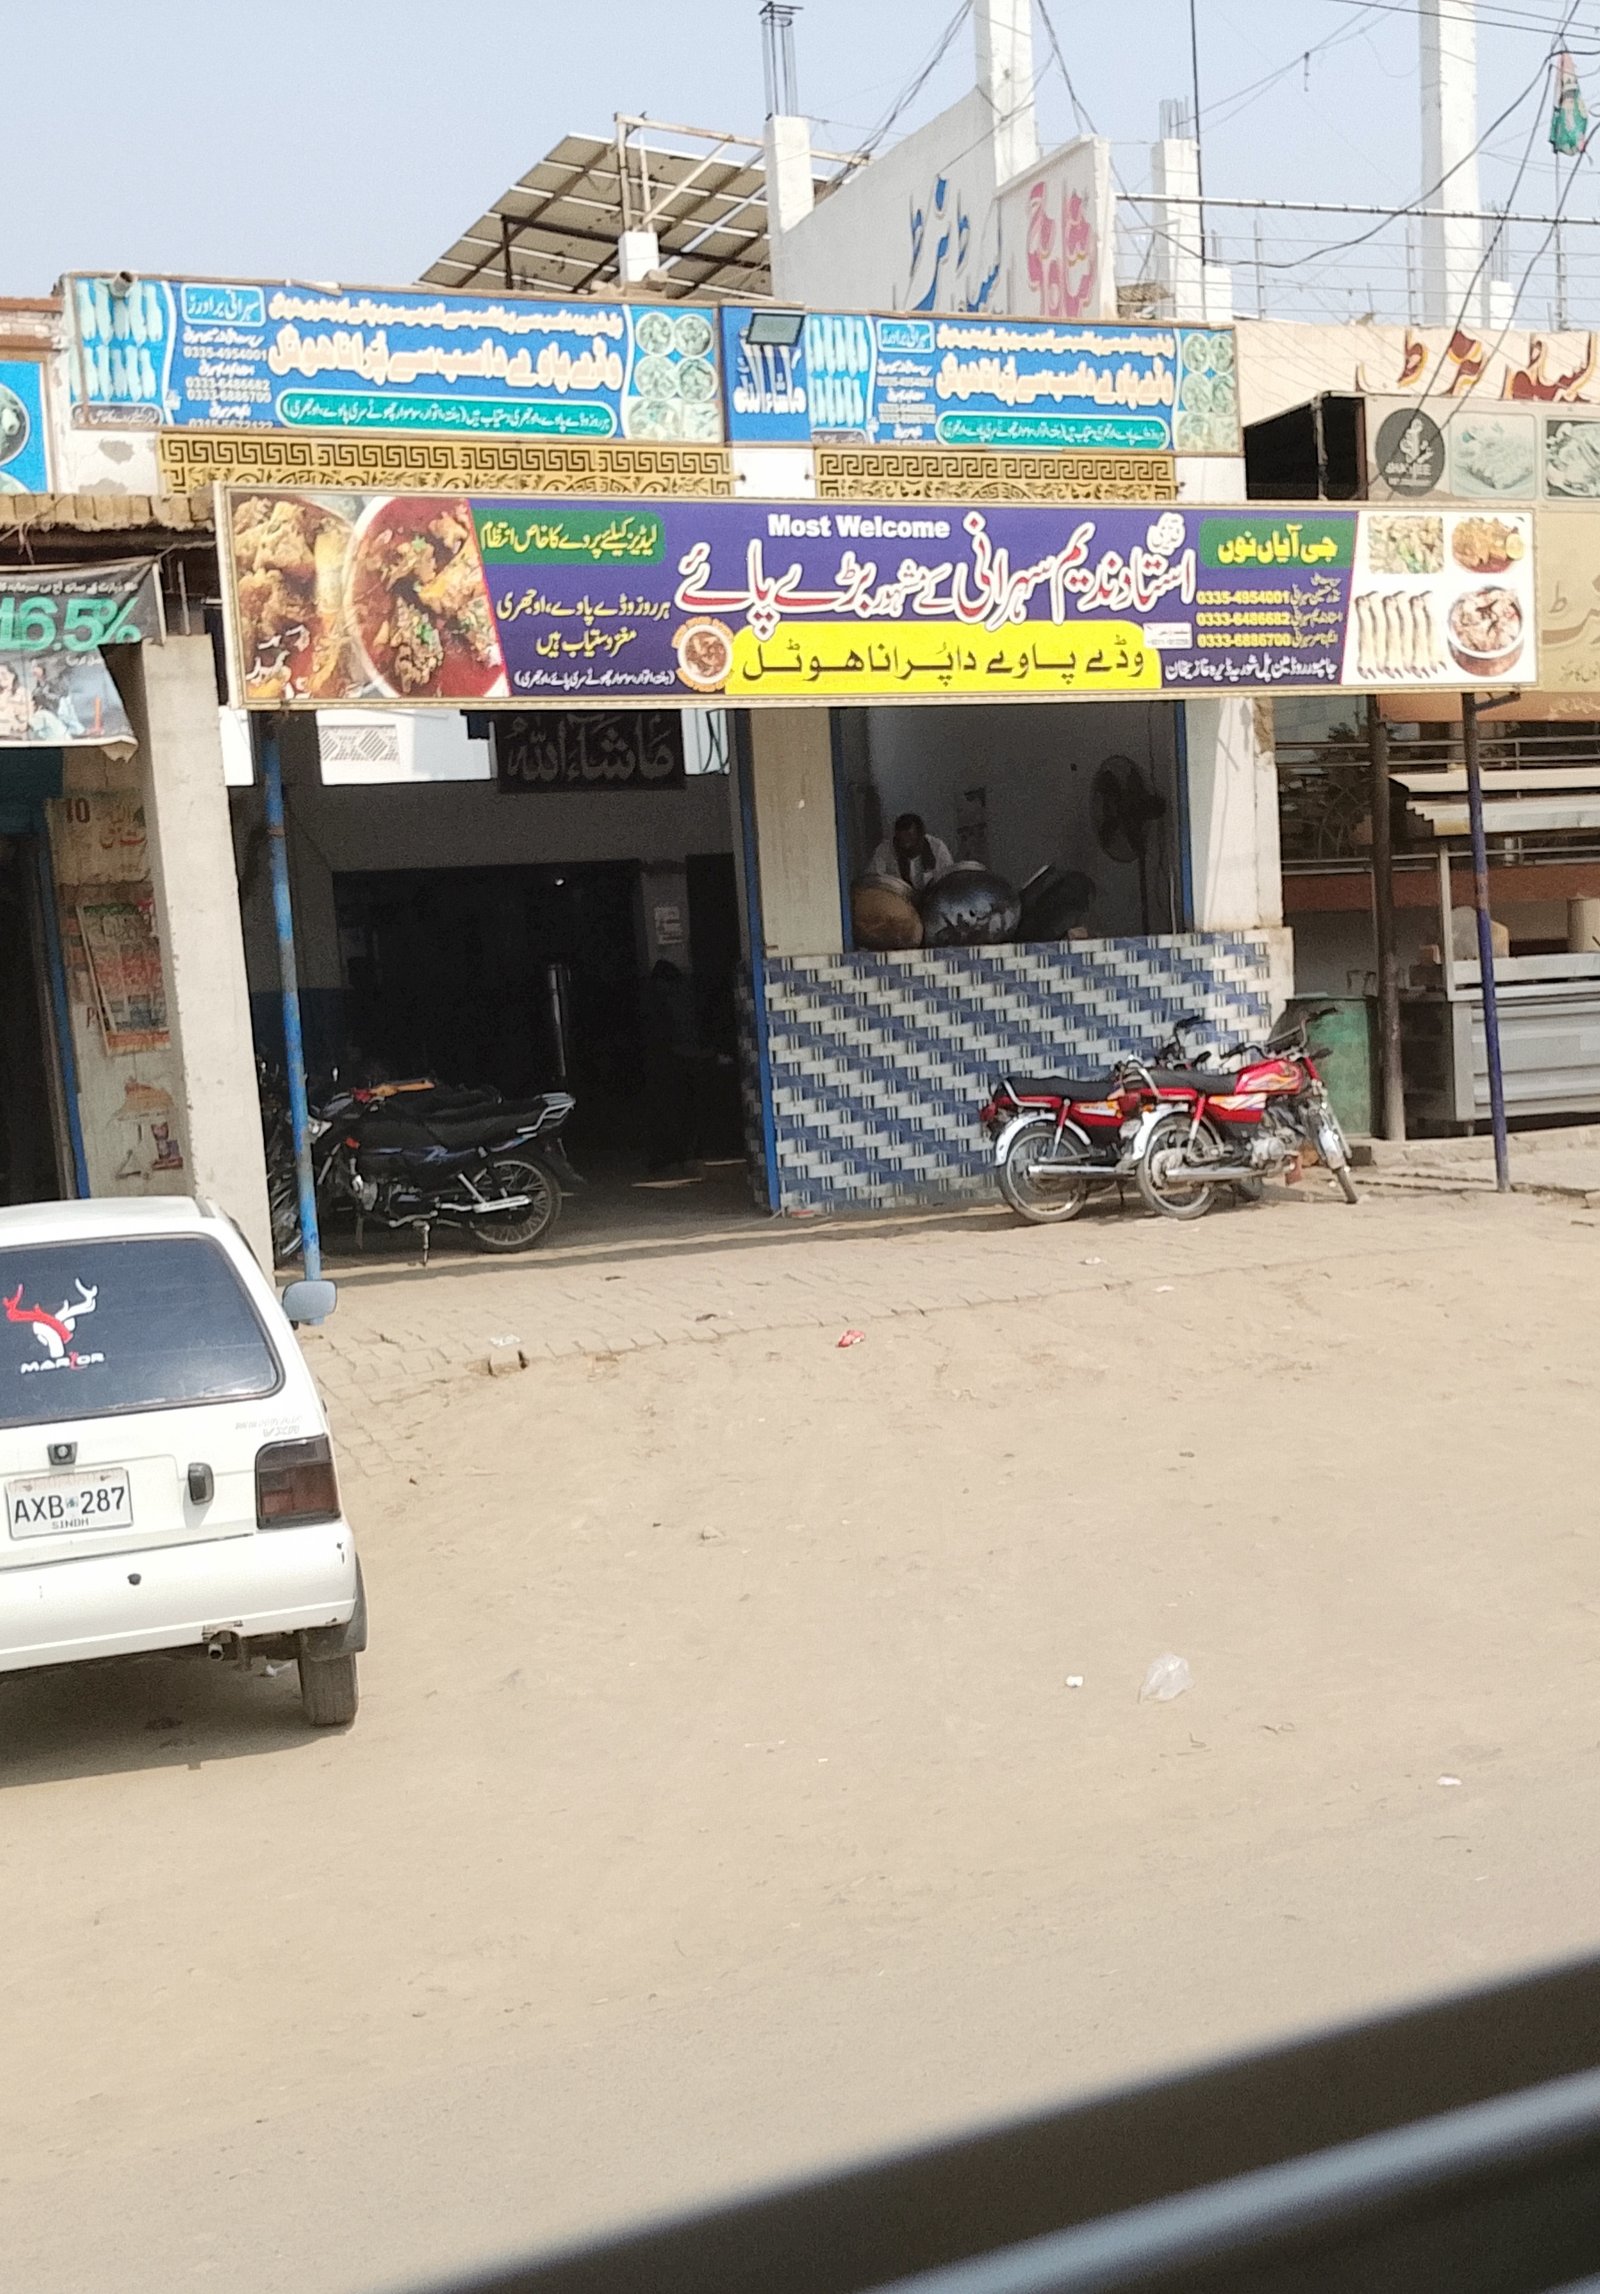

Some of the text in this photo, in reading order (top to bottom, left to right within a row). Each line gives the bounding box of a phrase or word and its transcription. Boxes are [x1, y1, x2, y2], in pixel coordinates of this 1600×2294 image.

[514, 523, 548, 553] خاص
[768, 513, 950, 538] Most Welcome
[1218, 530, 1257, 564] نوں
[1300, 536, 1338, 564] جی
[635, 595, 655, 617] روز
[654, 600, 671, 620] ہر
[1196, 590, 1290, 605] 0335-4954001
[535, 630, 561, 658] ہیں
[1086, 633, 1144, 678] وڈے
[985, 642, 1077, 686] پاوے
[14, 1486, 125, 1525] AXB 287
[52, 1517, 89, 1528] SINDH
